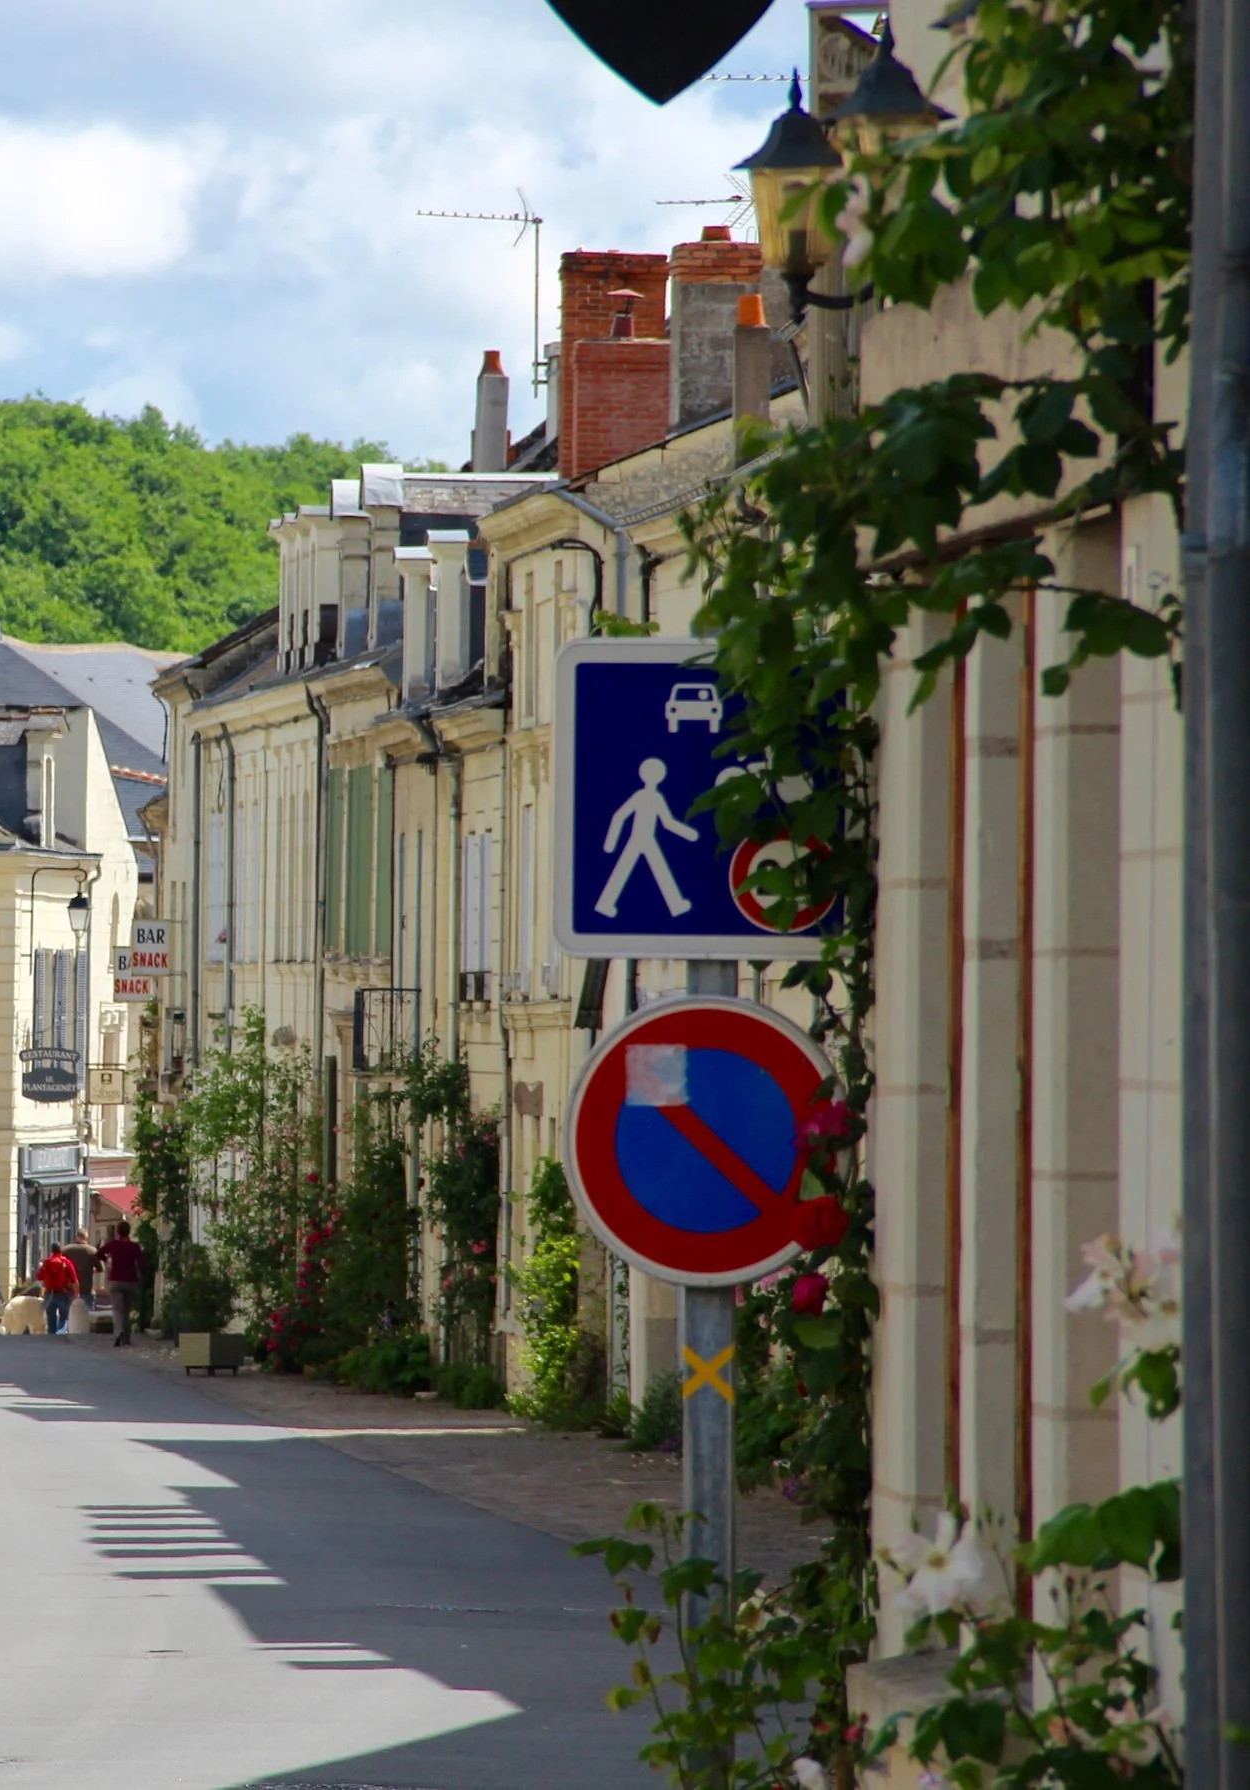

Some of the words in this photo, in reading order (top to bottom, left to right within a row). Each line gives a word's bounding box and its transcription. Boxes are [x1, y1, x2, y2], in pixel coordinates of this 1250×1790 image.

[137, 928, 165, 944] BAR
[132, 952, 168, 968] SNACK
[114, 979, 149, 994] SNACK
[22, 1049, 78, 1061] RESTAURANT
